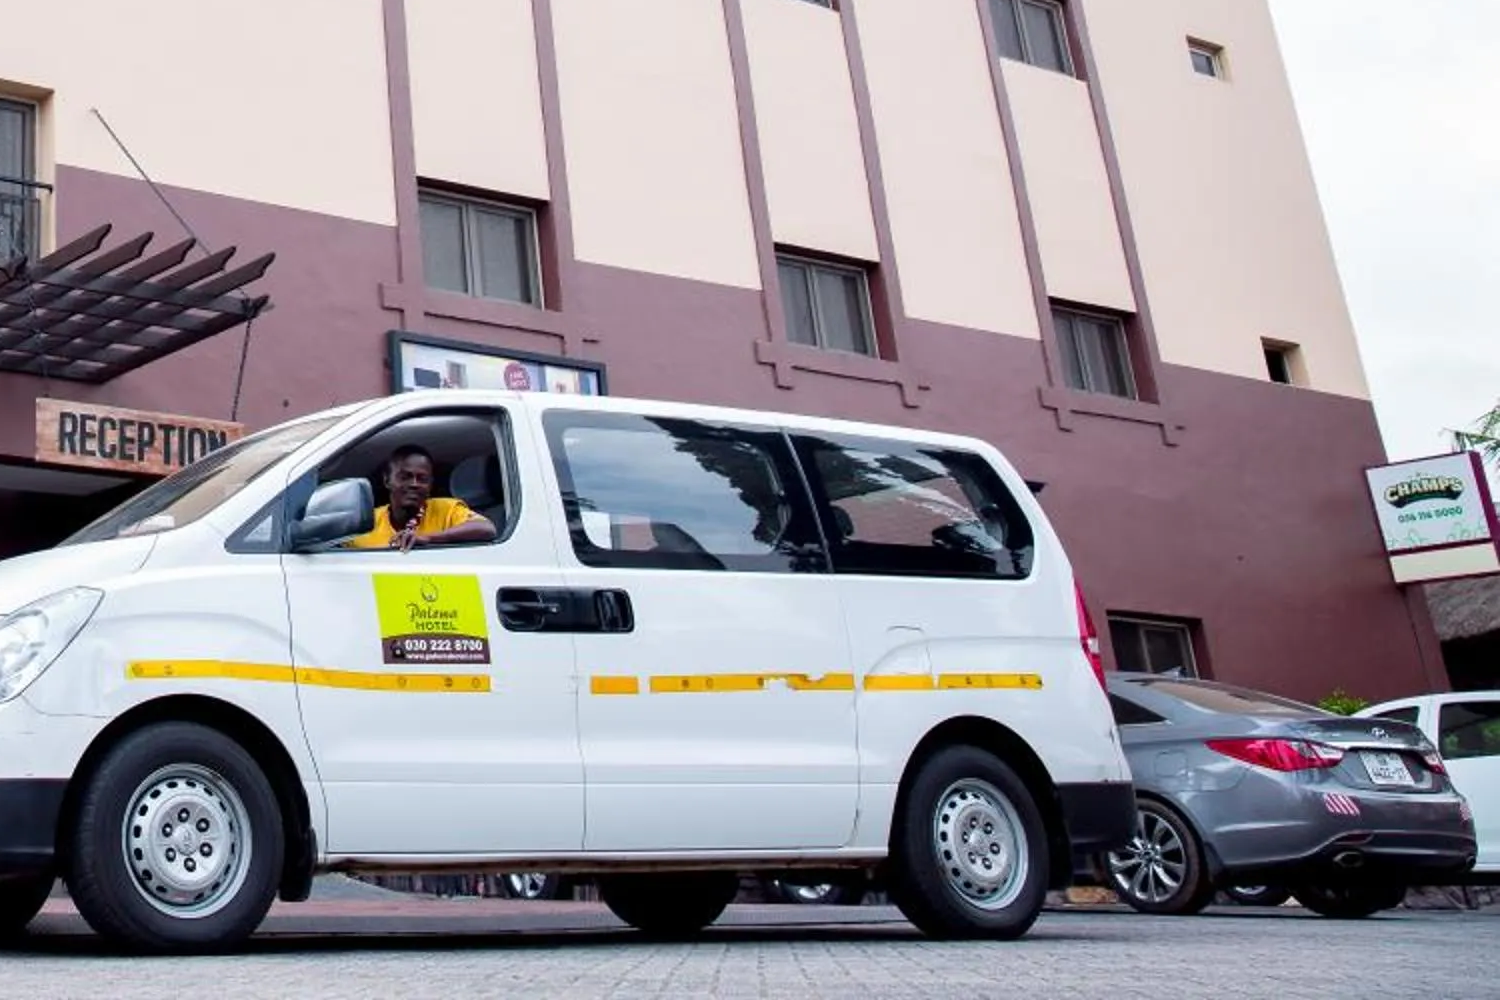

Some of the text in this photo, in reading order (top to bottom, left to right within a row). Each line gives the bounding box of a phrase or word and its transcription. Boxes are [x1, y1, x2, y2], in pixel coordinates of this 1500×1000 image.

[1384, 475, 1467, 503] CHAMPS
[406, 603, 457, 622] Paloma
[415, 621, 460, 631] HOTEL
[405, 639, 427, 651] 030
[430, 639, 452, 651] 222
